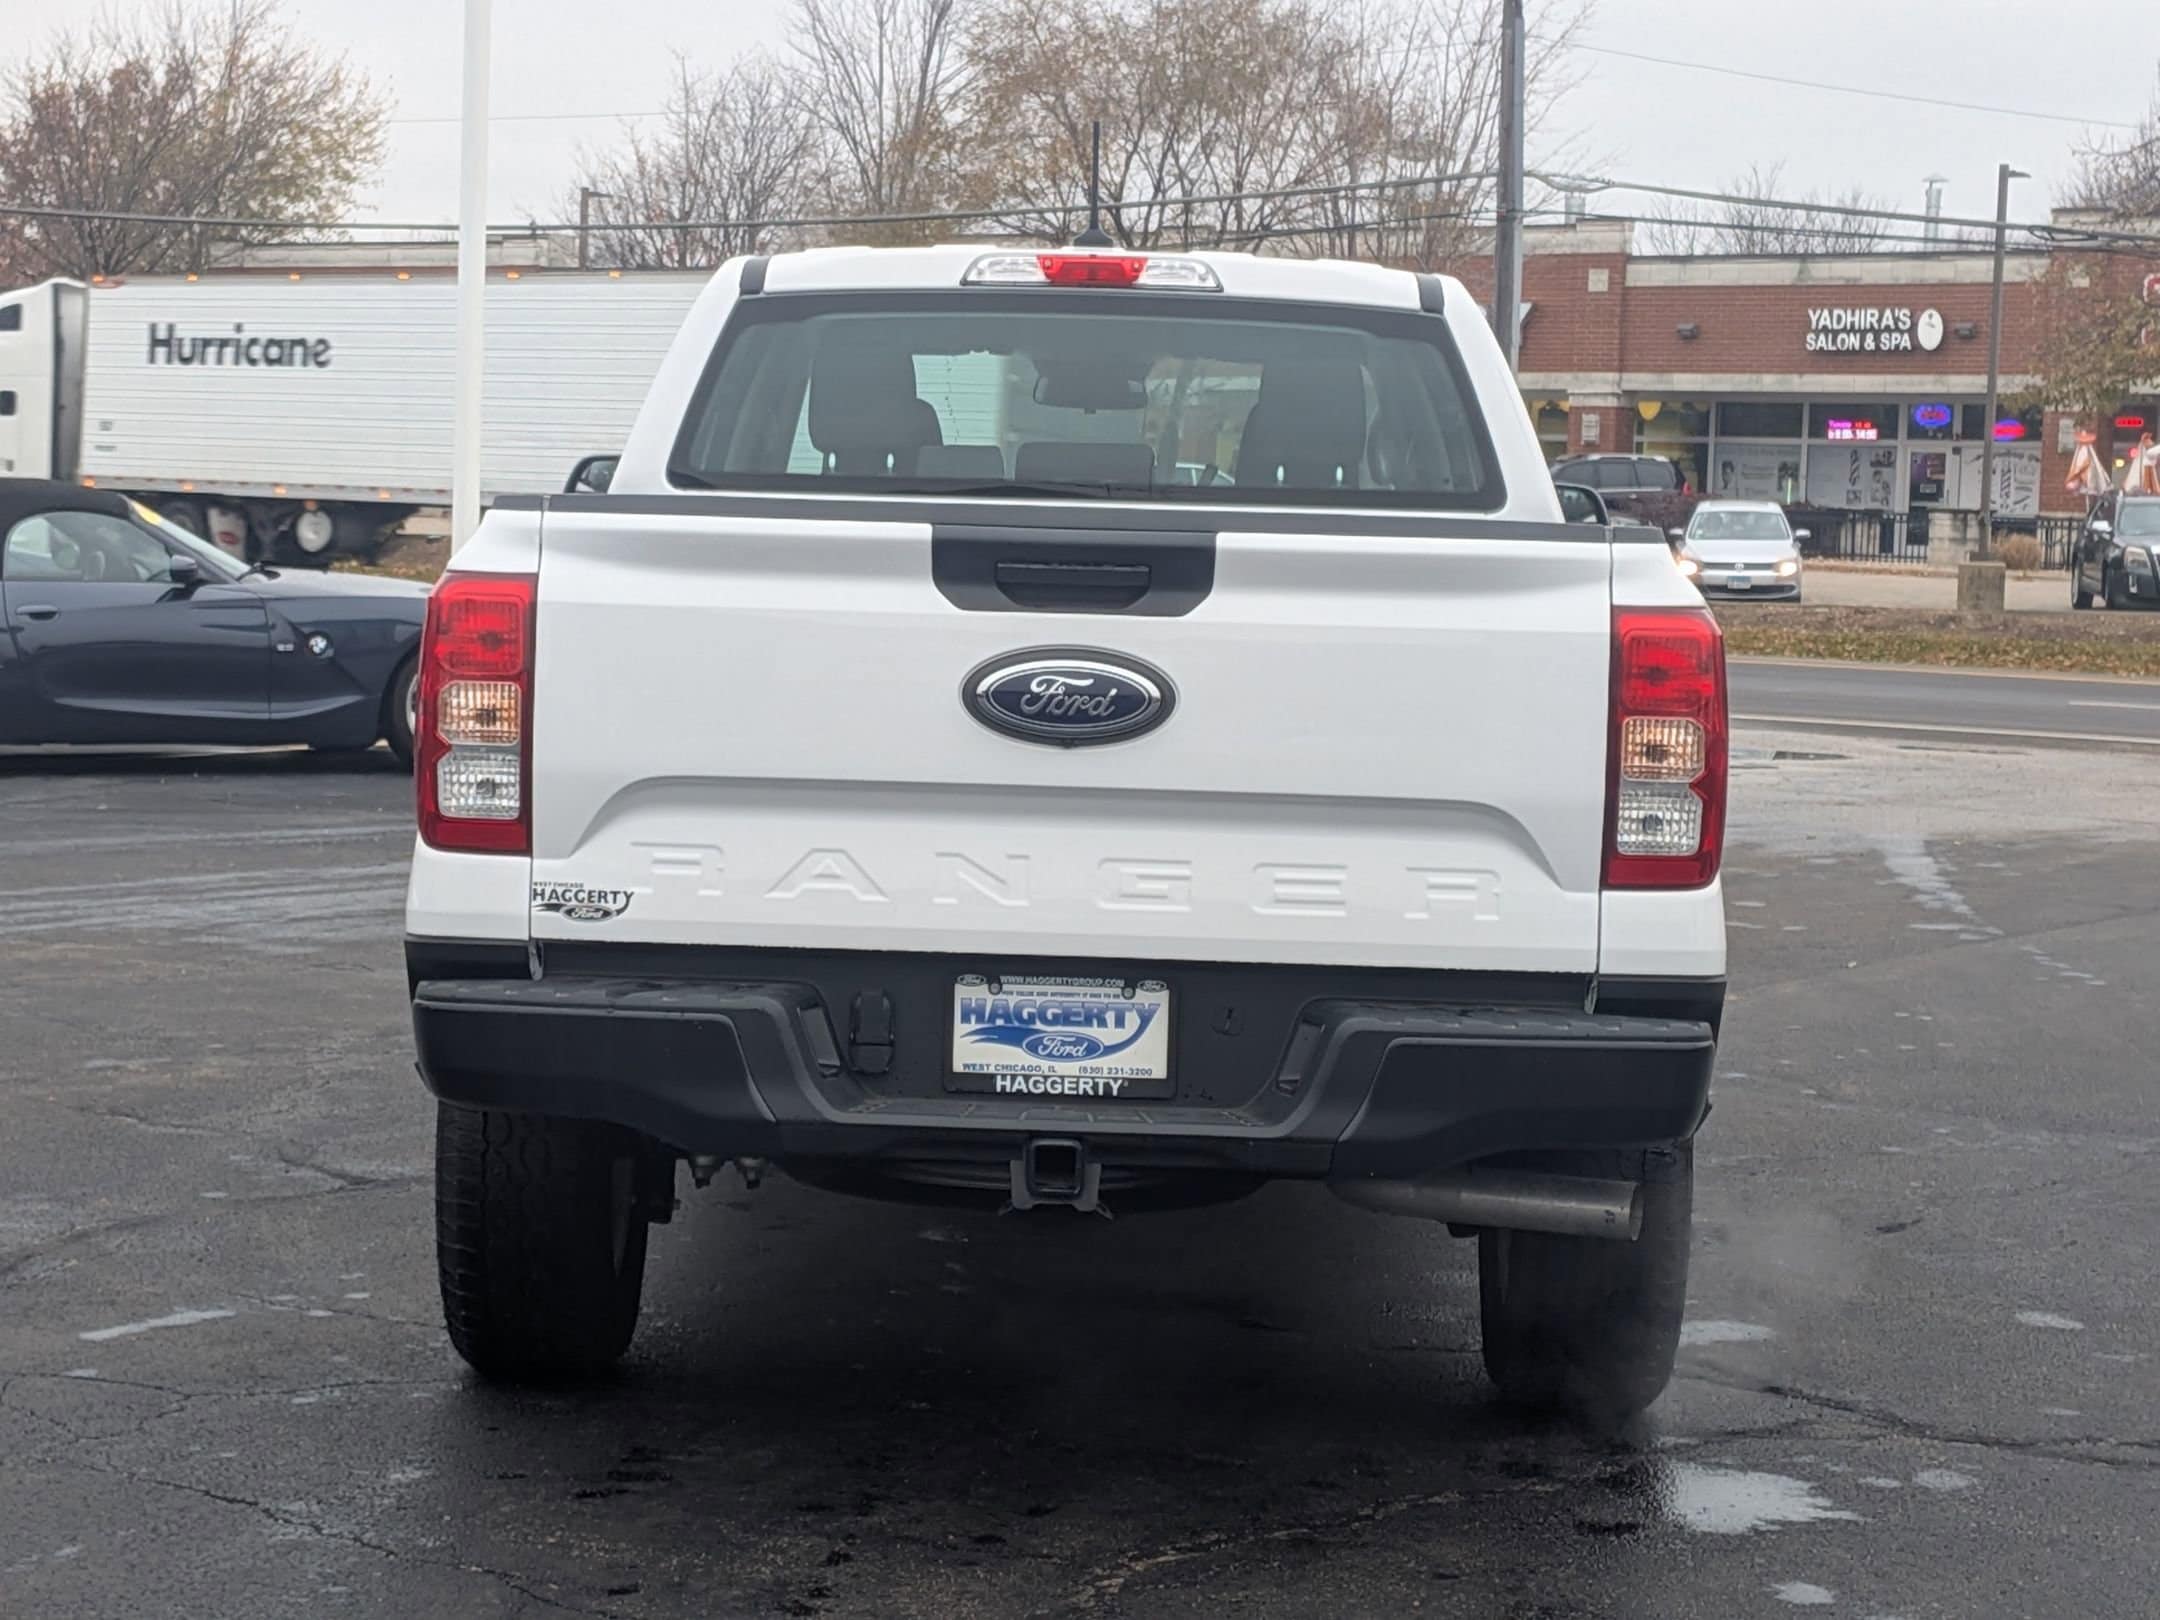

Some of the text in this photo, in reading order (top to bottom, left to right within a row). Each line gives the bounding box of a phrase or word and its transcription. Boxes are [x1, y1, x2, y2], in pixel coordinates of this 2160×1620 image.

[1808, 308, 1911, 331] YADHIRA'S
[148, 322, 332, 368] Hurricane
[1806, 333, 1912, 351] SALON & SPA
[1019, 674, 1118, 717] Ford
[629, 841, 1502, 921] RANGER
[532, 887, 634, 906] HAGGERTY
[959, 996, 1161, 1033] HAGGERTY
[1037, 1035, 1089, 1058] Ford
[962, 1063, 990, 1072] WEST
[994, 1063, 1045, 1074] CHICAGO,
[1048, 1065, 1058, 1073] IL
[1107, 1067, 1153, 1077] 231-3200
[995, 1075, 1123, 1097] HAGGERTY
